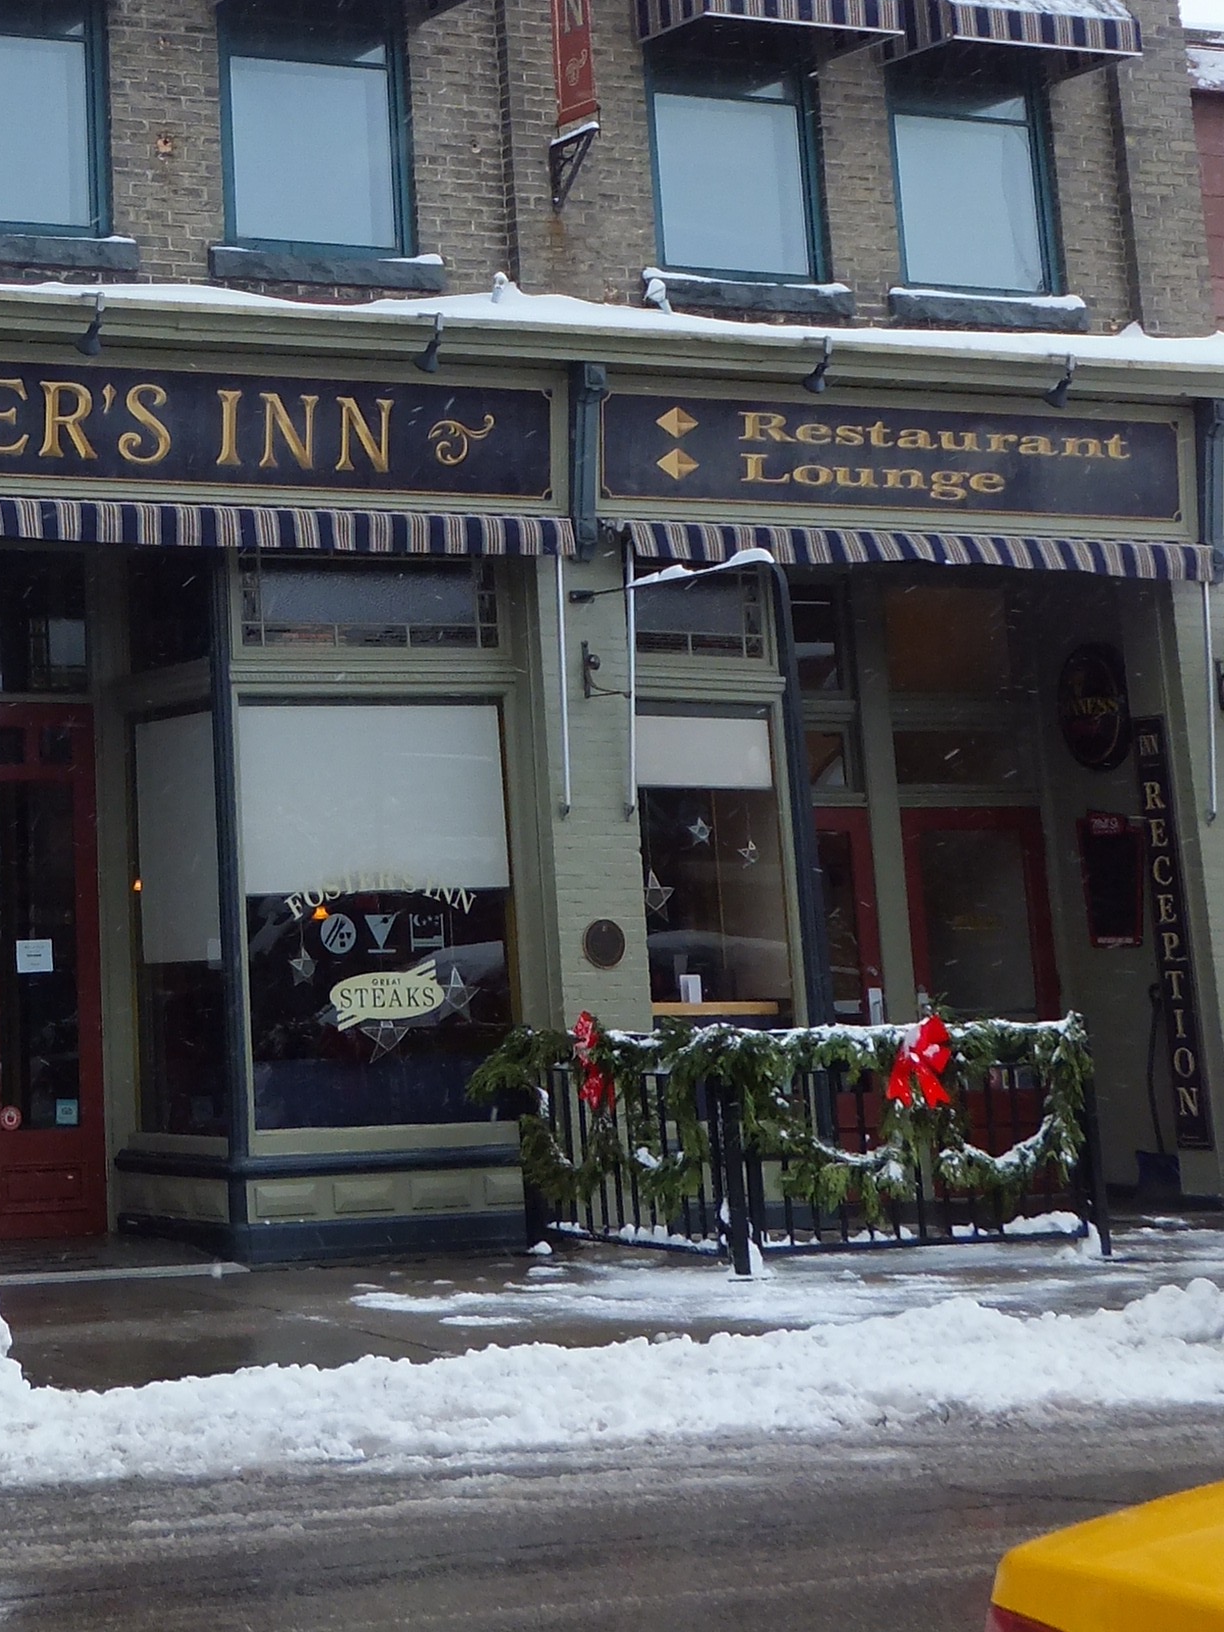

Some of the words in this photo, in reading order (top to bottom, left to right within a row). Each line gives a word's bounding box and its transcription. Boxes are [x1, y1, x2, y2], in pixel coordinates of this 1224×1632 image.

[216, 388, 395, 473] INN
[738, 410, 1130, 460] Restaurant
[740, 453, 1006, 501] Lounge
[422, 876, 477, 915] INN
[1143, 781, 1200, 1117] RECEPTION
[340, 987, 436, 1009] STEAKS
[371, 977, 402, 986] GREAT
